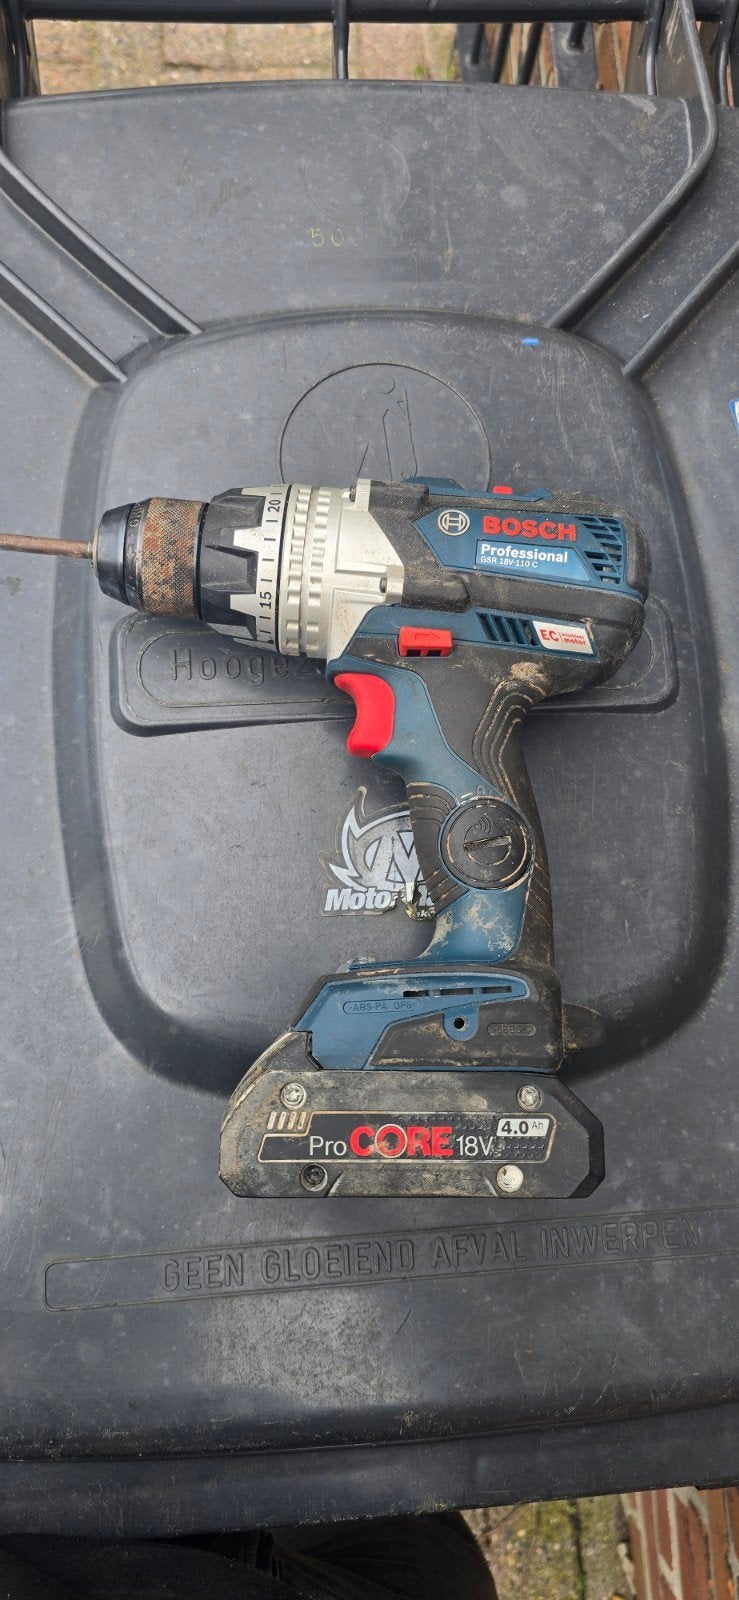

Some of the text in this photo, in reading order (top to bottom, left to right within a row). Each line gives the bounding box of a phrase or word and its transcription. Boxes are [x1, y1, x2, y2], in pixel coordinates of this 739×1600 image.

[267, 499, 282, 513] 20
[482, 515, 577, 542] BOSCH
[481, 543, 568, 563] Professional
[480, 556, 497, 565] GSR
[499, 558, 531, 568] 18V-110
[259, 591, 272, 609] 15
[539, 628, 560, 642] EC
[563, 637, 587, 646] motor
[501, 1120, 544, 1135] 4.0 Ah
[309, 1124, 494, 1158] Pro CORE 18V
[162, 1216, 701, 1292] GEEN GLOEIEND AFVAL INWERPEN
